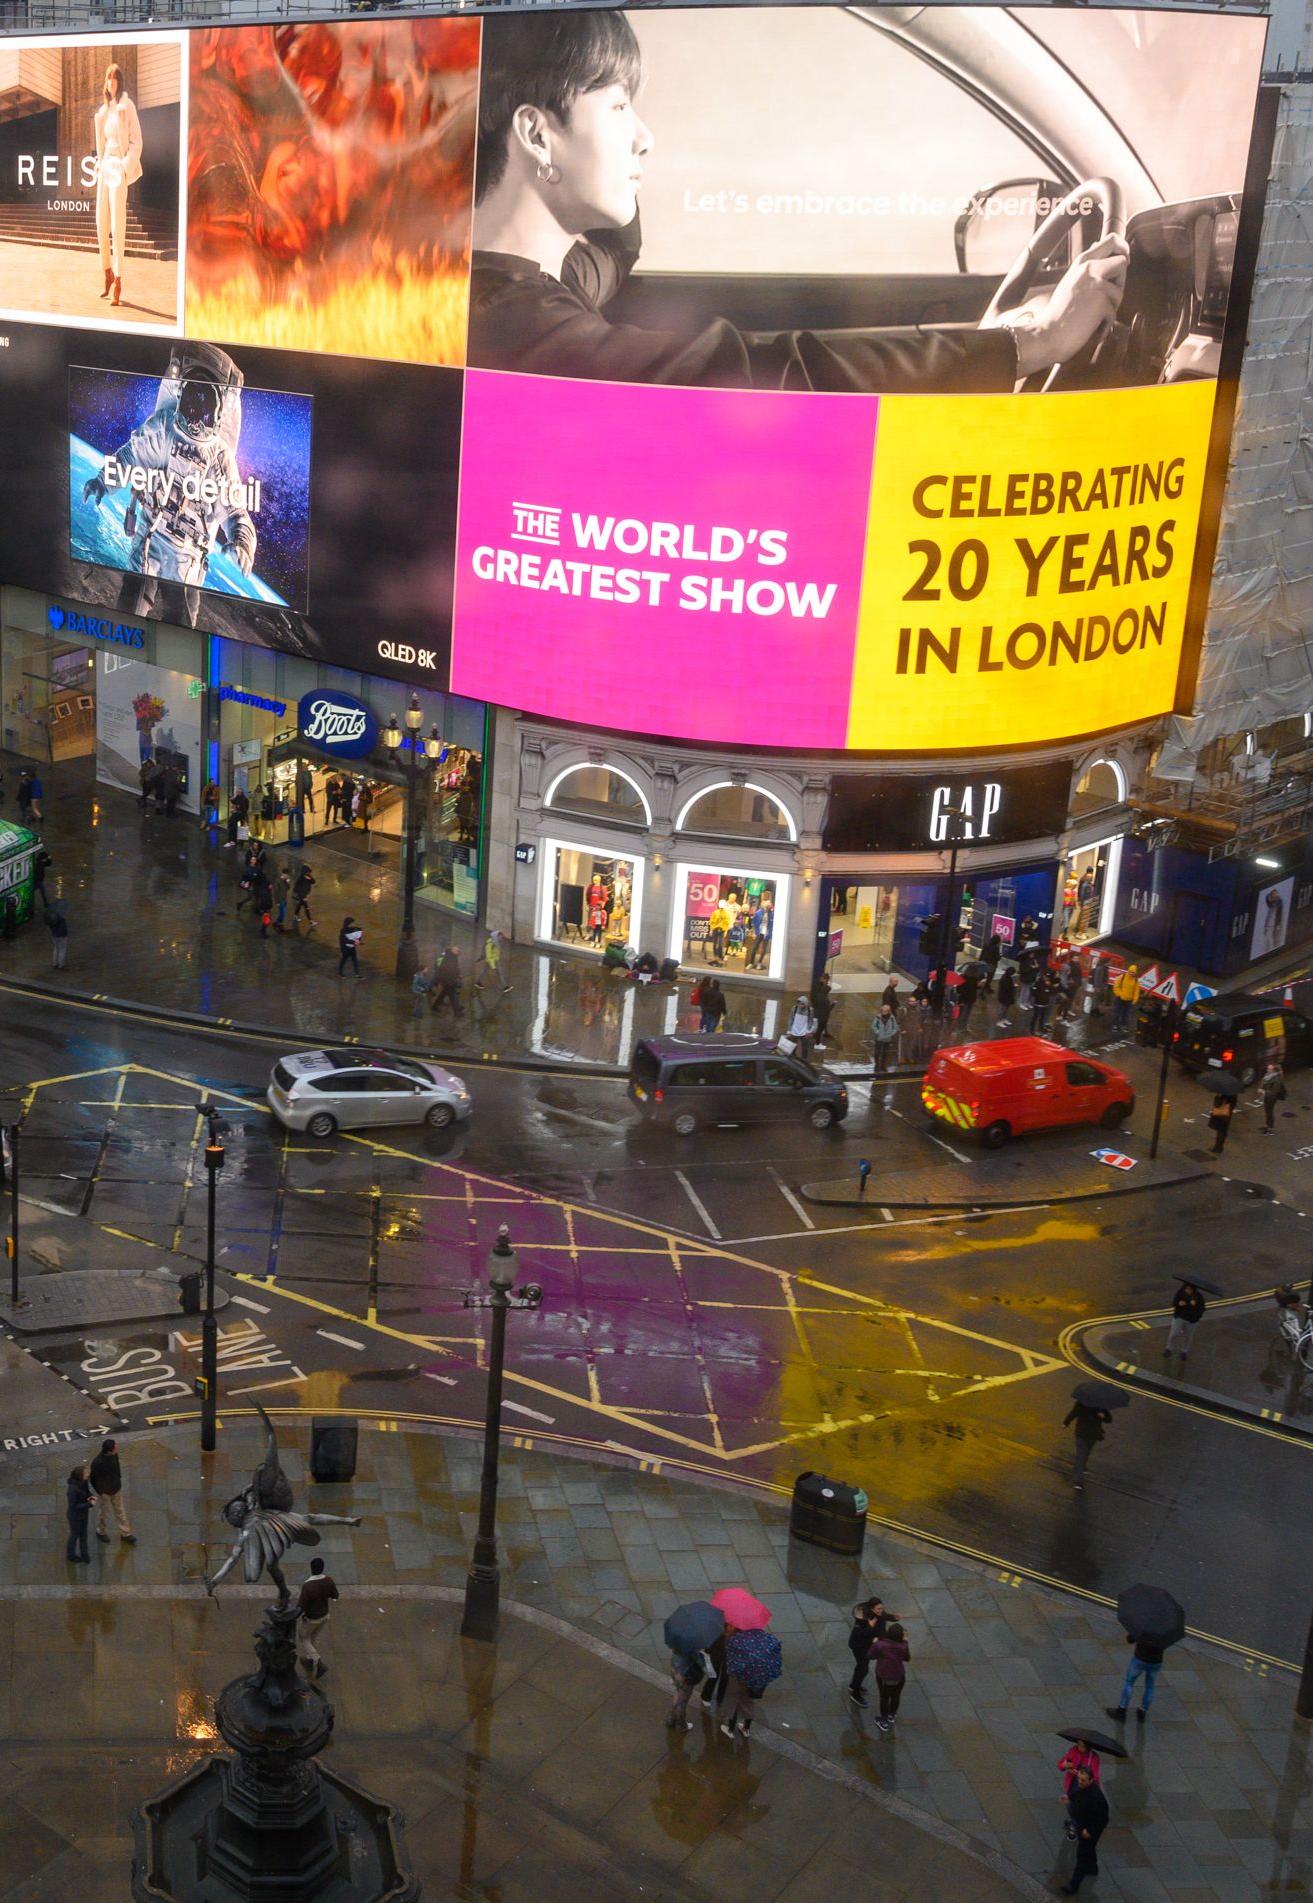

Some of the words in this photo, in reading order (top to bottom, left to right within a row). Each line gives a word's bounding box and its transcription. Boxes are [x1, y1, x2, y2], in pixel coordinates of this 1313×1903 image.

[17, 154, 123, 188] REISS
[47, 200, 91, 213] LONDON
[683, 188, 748, 214] Let's
[757, 189, 890, 217] embrace
[899, 190, 945, 216] the
[954, 190, 1093, 221] experience
[104, 454, 174, 496] Every
[182, 472, 262, 514] detail
[912, 456, 1185, 519] CELEBRATING
[514, 509, 560, 540] THE
[572, 512, 788, 566] WORLD'S
[901, 538, 988, 601] 20
[1012, 518, 1177, 598] YEARS
[471, 545, 670, 607] GREATEST
[679, 574, 838, 620] SHOW
[66, 611, 144, 649] BARCLAYS
[894, 625, 963, 675] IN
[977, 602, 1168, 673] LONDON
[377, 639, 415, 666] QLED
[416, 646, 438, 671] 8K
[219, 685, 287, 718] pharmacy
[303, 700, 367, 743] Boots
[929, 783, 1002, 842] GAP
[689, 883, 718, 903] 50
[1130, 887, 1160, 914] GAP
[689, 931, 709, 939] OUT
[995, 923, 1010, 936] 50
[1231, 912, 1249, 938] GAP
[173, 1317, 309, 1397] LANE
[80, 1347, 195, 1411] BUS
[3, 1430, 74, 1452] RIGHT
